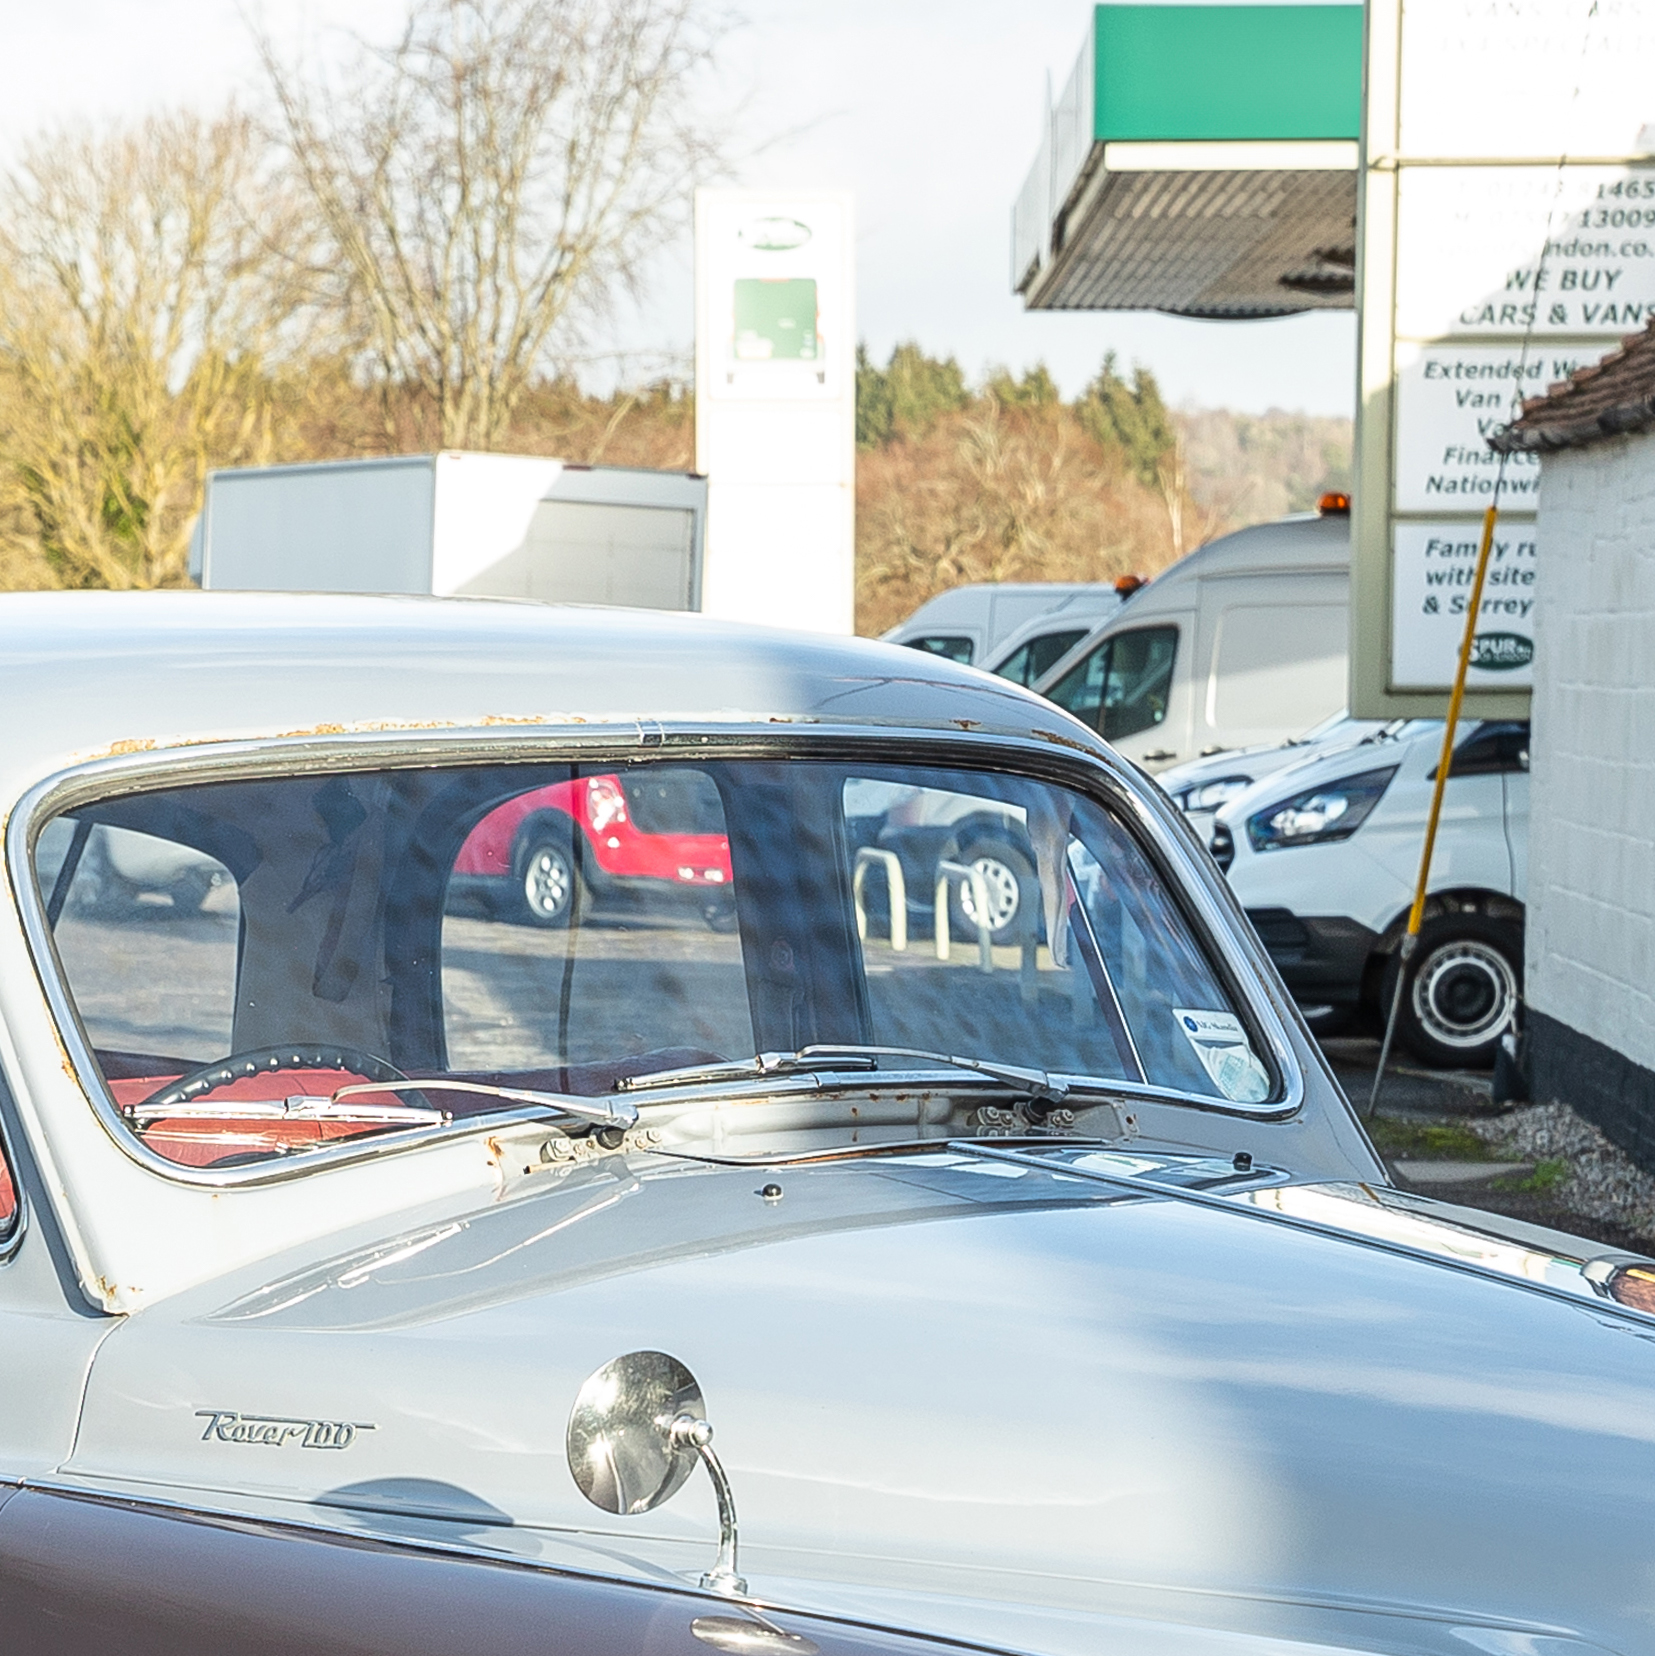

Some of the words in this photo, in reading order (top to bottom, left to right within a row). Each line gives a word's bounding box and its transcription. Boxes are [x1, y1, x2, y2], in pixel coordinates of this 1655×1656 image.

[1505, 269, 1550, 291] WE
[1560, 269, 1623, 291] BUY
[1459, 303, 1537, 326] CARS
[1548, 303, 1568, 325] &
[1423, 360, 1543, 380] Extended
[1455, 389, 1501, 409] Van
[1425, 538, 1509, 561] Famy
[1488, 565, 1536, 586] site
[1422, 595, 1440, 615] &
[1448, 595, 1535, 618] Srrey
[194, 1410, 293, 1447] Rover
[301, 1419, 358, 1449] 100
